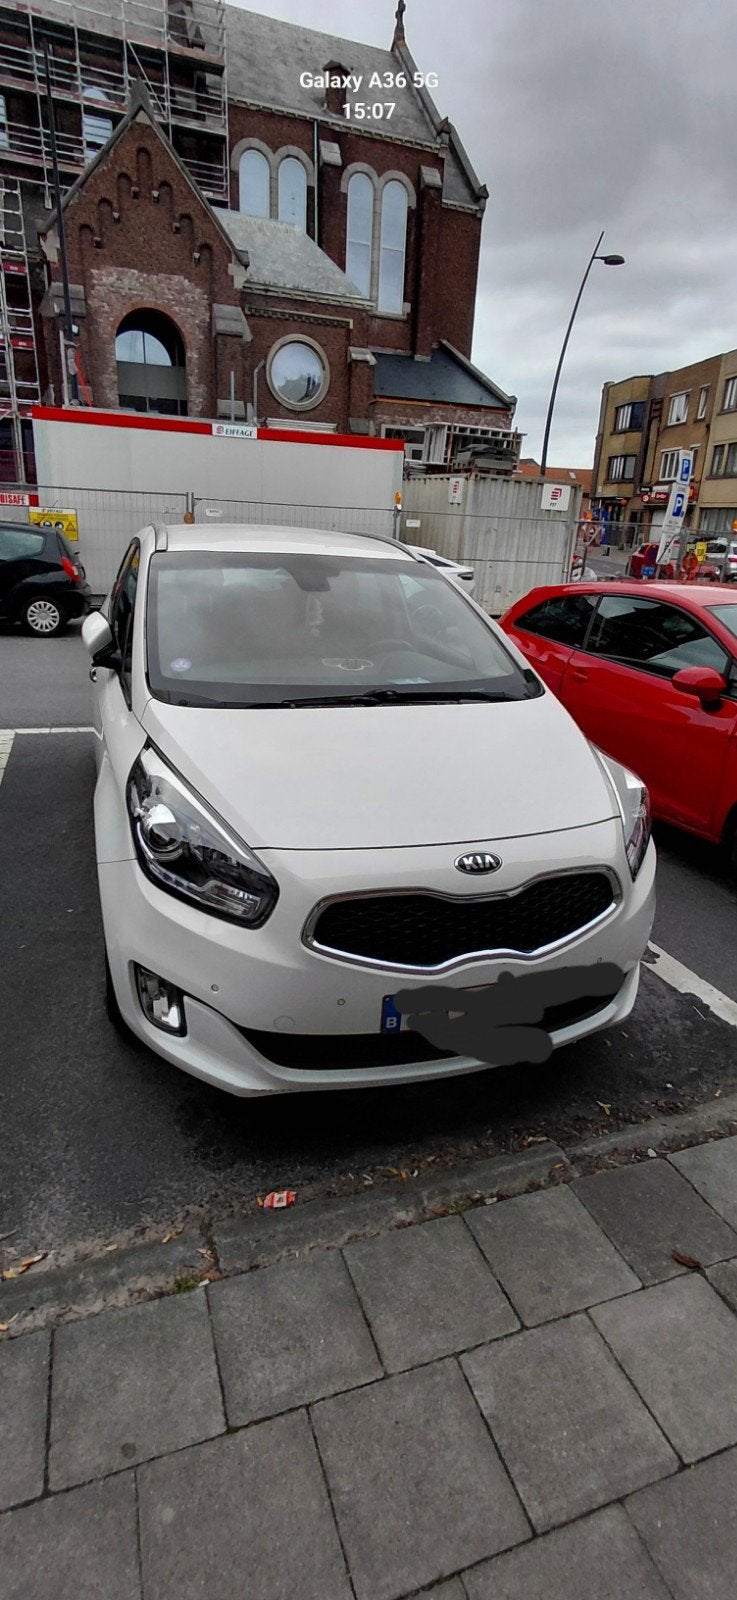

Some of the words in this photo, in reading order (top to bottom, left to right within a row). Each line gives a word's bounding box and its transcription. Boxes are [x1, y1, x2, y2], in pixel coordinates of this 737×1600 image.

[225, 428, 254, 437] EIFFAGE
[462, 854, 497, 870] KIA
[385, 1016, 398, 1029] B
